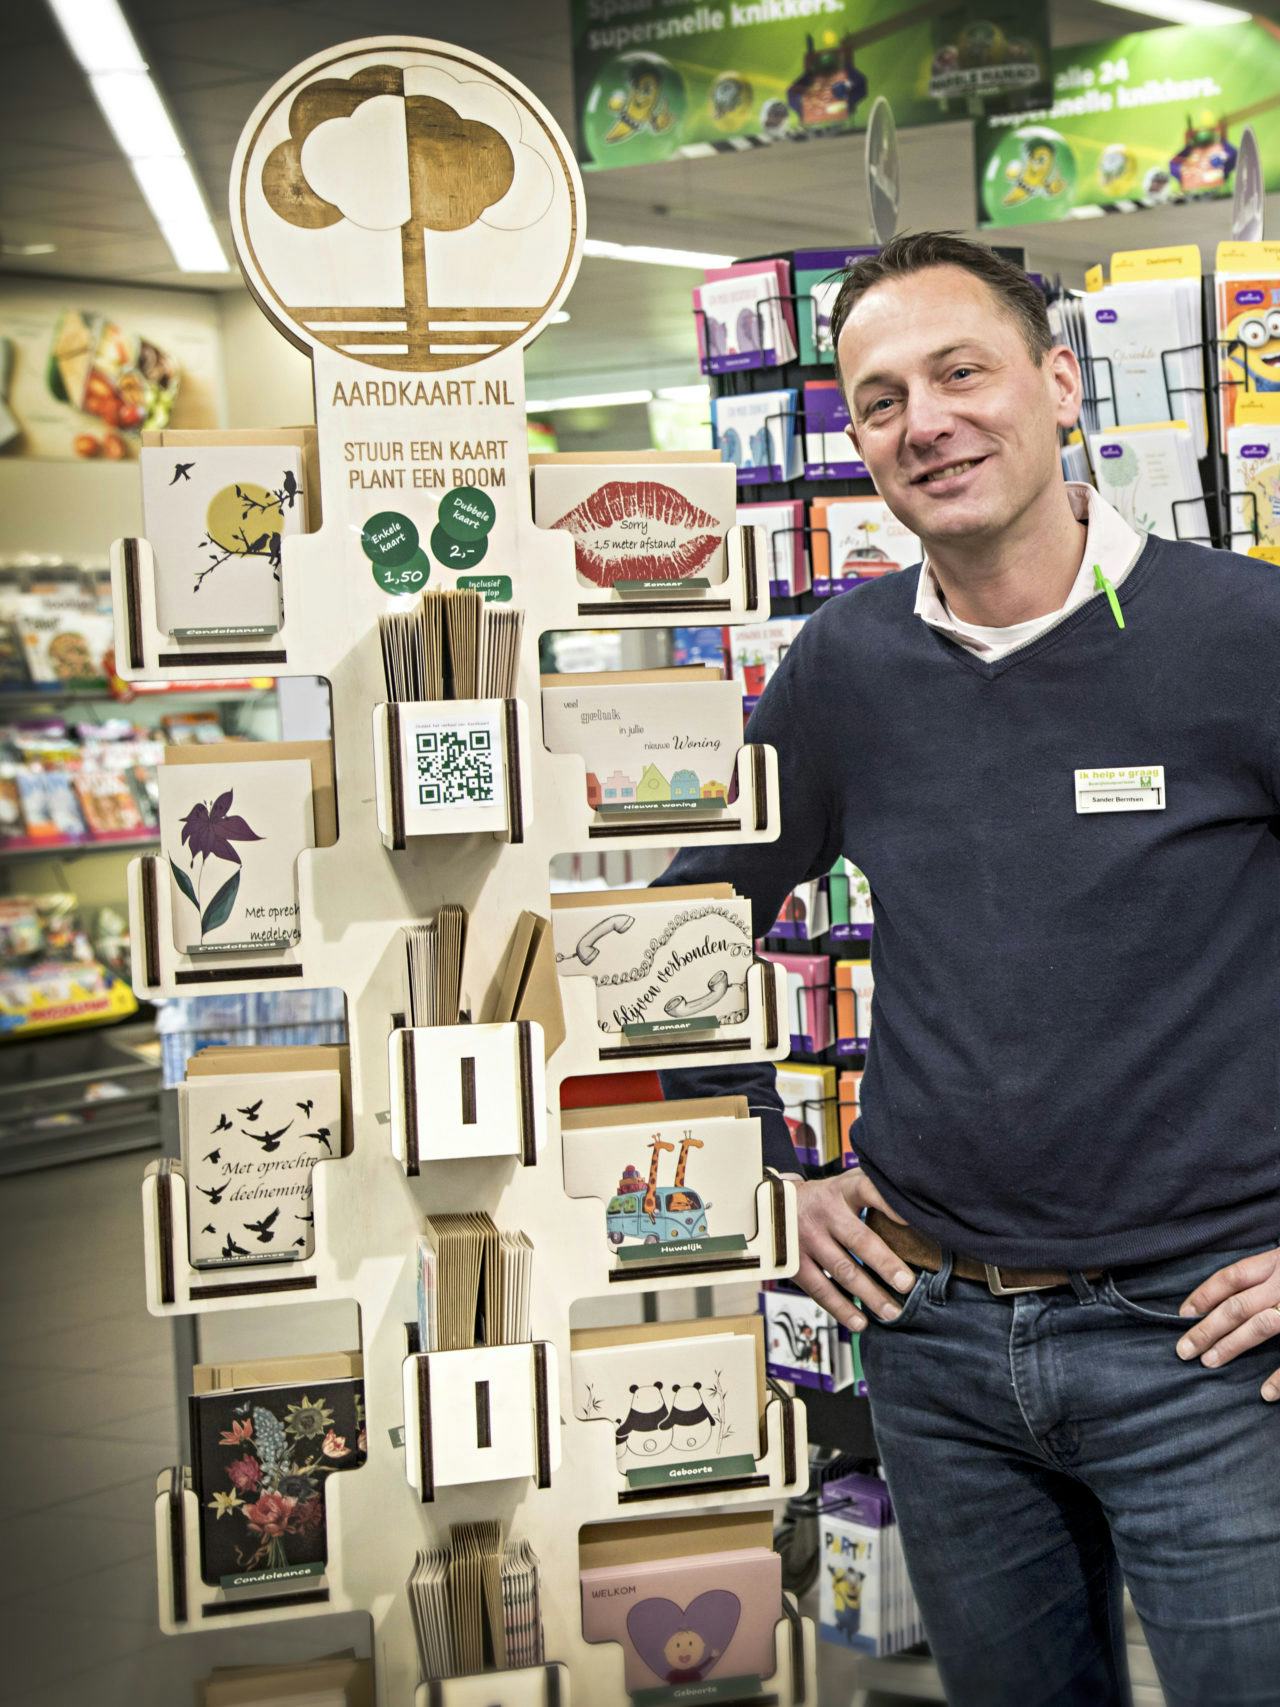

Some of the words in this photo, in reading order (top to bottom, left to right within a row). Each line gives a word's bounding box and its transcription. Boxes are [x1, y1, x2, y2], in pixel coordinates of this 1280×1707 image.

[588, 9, 724, 49] supersnelle
[1098, 58, 1130, 83] 24
[331, 380, 515, 407] AARDKAART.NL
[344, 441, 404, 462] STUUR
[411, 440, 443, 461] EEN
[450, 440, 508, 460] KAART
[349, 469, 406, 489] PLANT
[413, 468, 446, 488] EEN
[453, 467, 506, 488] BOOM
[453, 497, 490, 523] Dubbele
[452, 510, 480, 530] kaart
[620, 519, 649, 535] Sorry
[371, 521, 402, 545] Enkele
[379, 532, 406, 554] kaart
[594, 540, 610, 551] 1,5
[612, 540, 639, 550] meter
[639, 537, 677, 552] afstand
[449, 544, 475, 560] 2,-
[383, 570, 423, 585] 1,50
[468, 578, 501, 589] Inclusief
[643, 580, 683, 588] Zomaar
[186, 626, 265, 636] Condoleance
[619, 725, 628, 734] in
[628, 724, 645, 738] jullie
[672, 735, 722, 751] Woning
[662, 801, 697, 810] woning
[245, 906, 266, 919] Met
[613, 984, 662, 1028] blijven
[658, 935, 728, 983] verbonden
[652, 1022, 692, 1032] Zomaar
[221, 1161, 253, 1176] Met
[257, 1152, 318, 1178] oprechte
[229, 1182, 313, 1202] deelneming
[660, 1243, 703, 1254] Huwelijk
[668, 1465, 713, 1478] Geboorte
[233, 1567, 312, 1586] Condoleance
[591, 1585, 637, 1599] WELKOM
[673, 1685, 718, 1698] Geboorte
